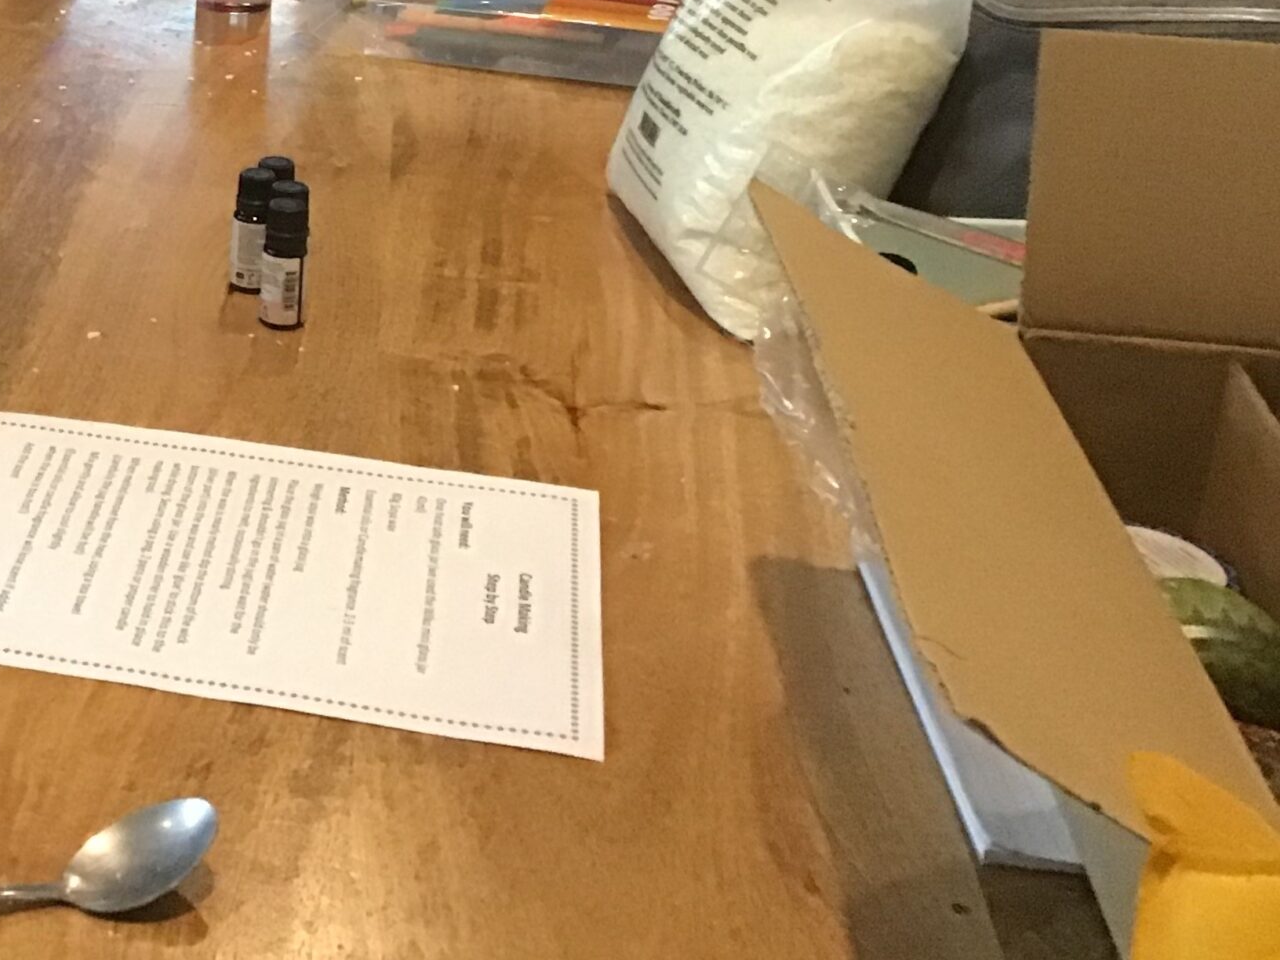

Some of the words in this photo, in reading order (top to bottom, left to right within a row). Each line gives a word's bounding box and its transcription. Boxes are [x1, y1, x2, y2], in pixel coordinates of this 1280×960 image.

[335, 486, 351, 514] Method:
[461, 502, 473, 516] You
[461, 517, 473, 529] will
[459, 529, 470, 549] need:
[484, 573, 500, 593] Step
[518, 573, 532, 601] Candle
[483, 593, 499, 604] by
[482, 605, 498, 624] Step
[514, 602, 531, 634] Making
